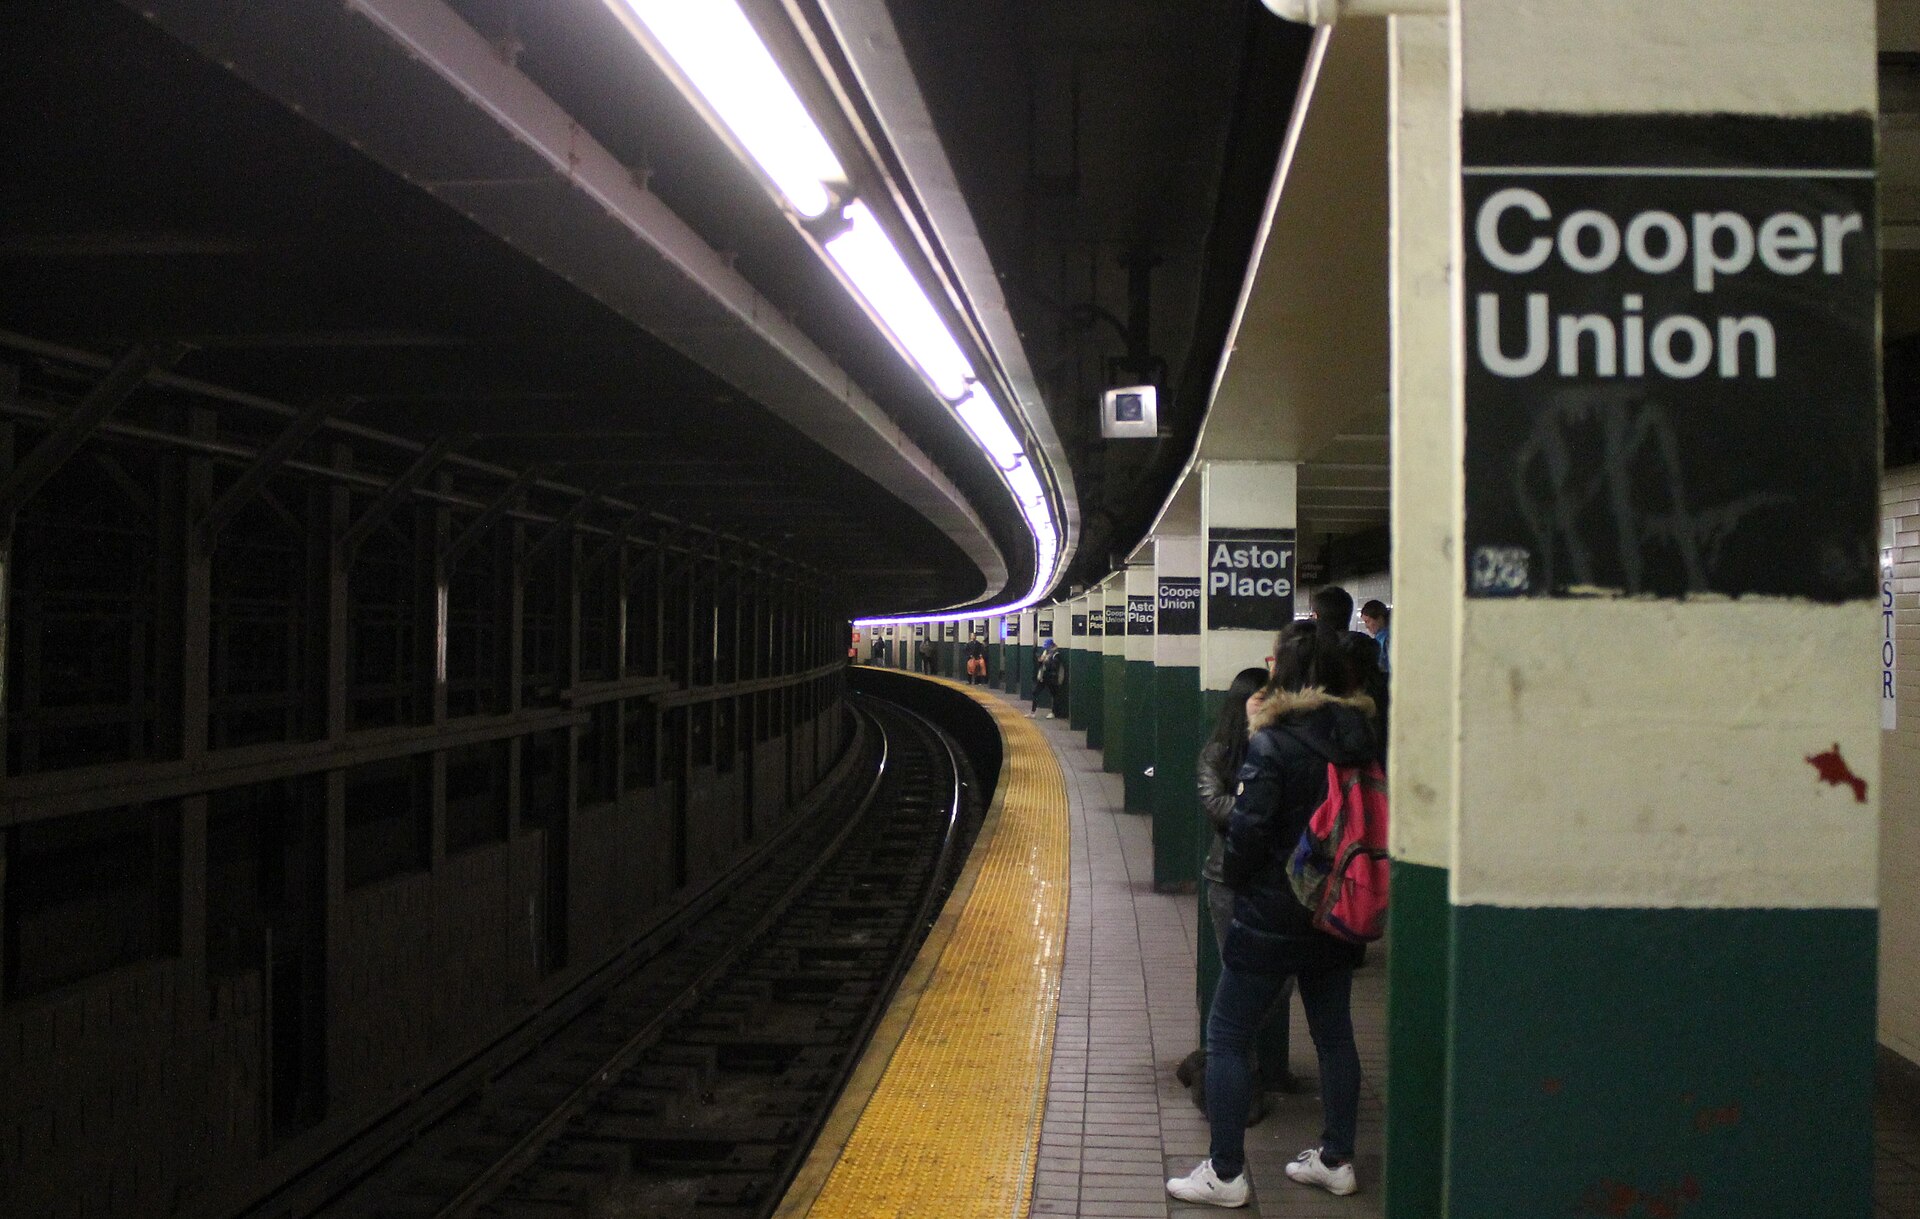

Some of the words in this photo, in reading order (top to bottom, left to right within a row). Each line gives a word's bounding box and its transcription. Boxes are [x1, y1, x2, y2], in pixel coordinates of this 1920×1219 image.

[1475, 187, 1863, 293] Cooper
[1476, 294, 1777, 379] Union
[1211, 543, 1292, 569] Astor
[1210, 572, 1291, 597] Place
[1159, 586, 1200, 599] Coope
[1128, 601, 1154, 612] Asto
[1159, 599, 1195, 609] Union
[1105, 609, 1126, 618] Coop
[1128, 612, 1154, 623] Plac
